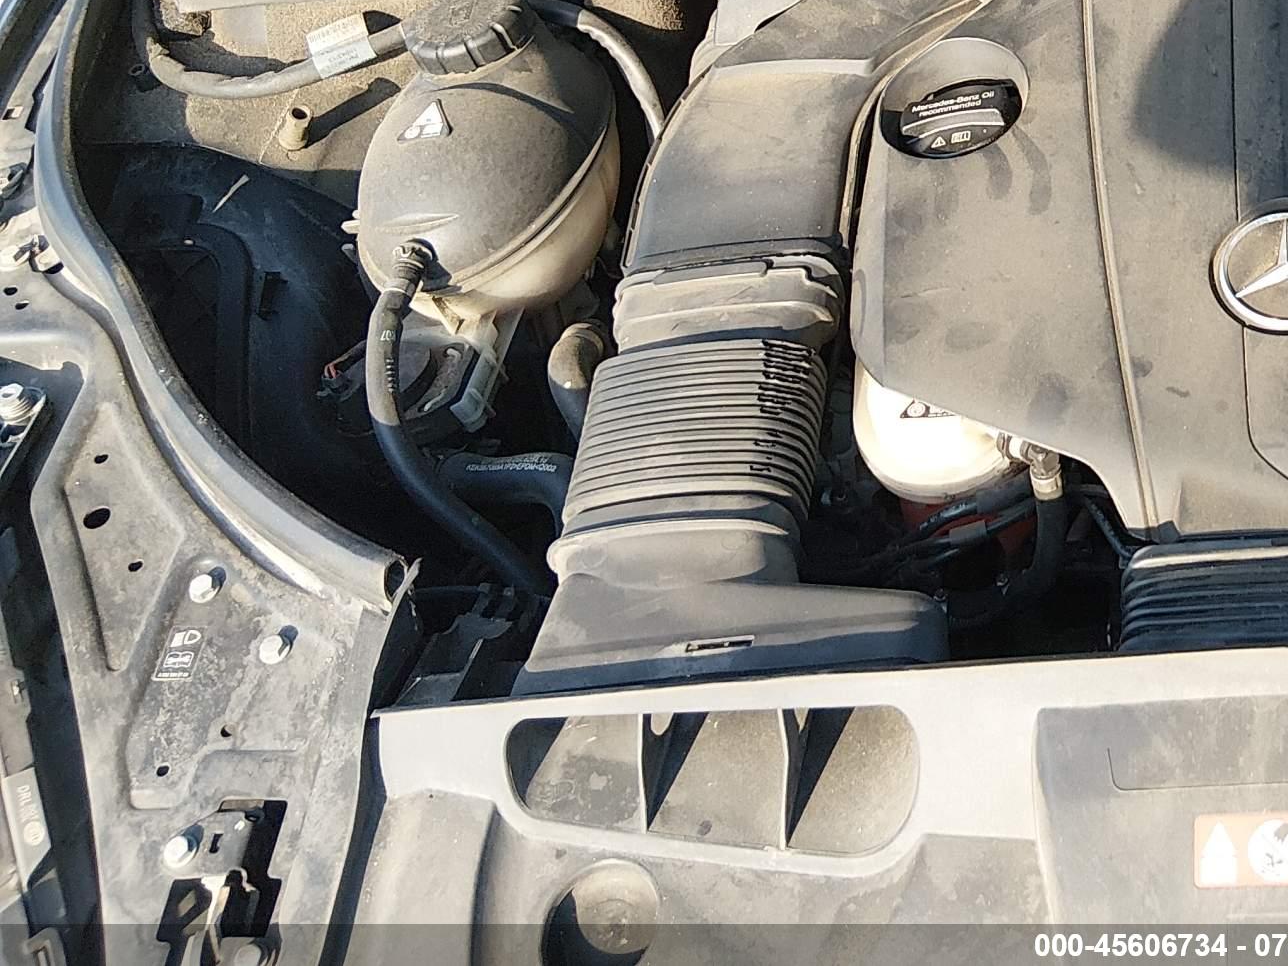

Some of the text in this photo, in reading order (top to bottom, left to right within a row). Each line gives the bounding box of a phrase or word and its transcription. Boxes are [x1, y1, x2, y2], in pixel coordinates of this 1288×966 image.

[911, 90, 995, 113] Mercedes-Benz Oil
[918, 99, 982, 117] recommended
